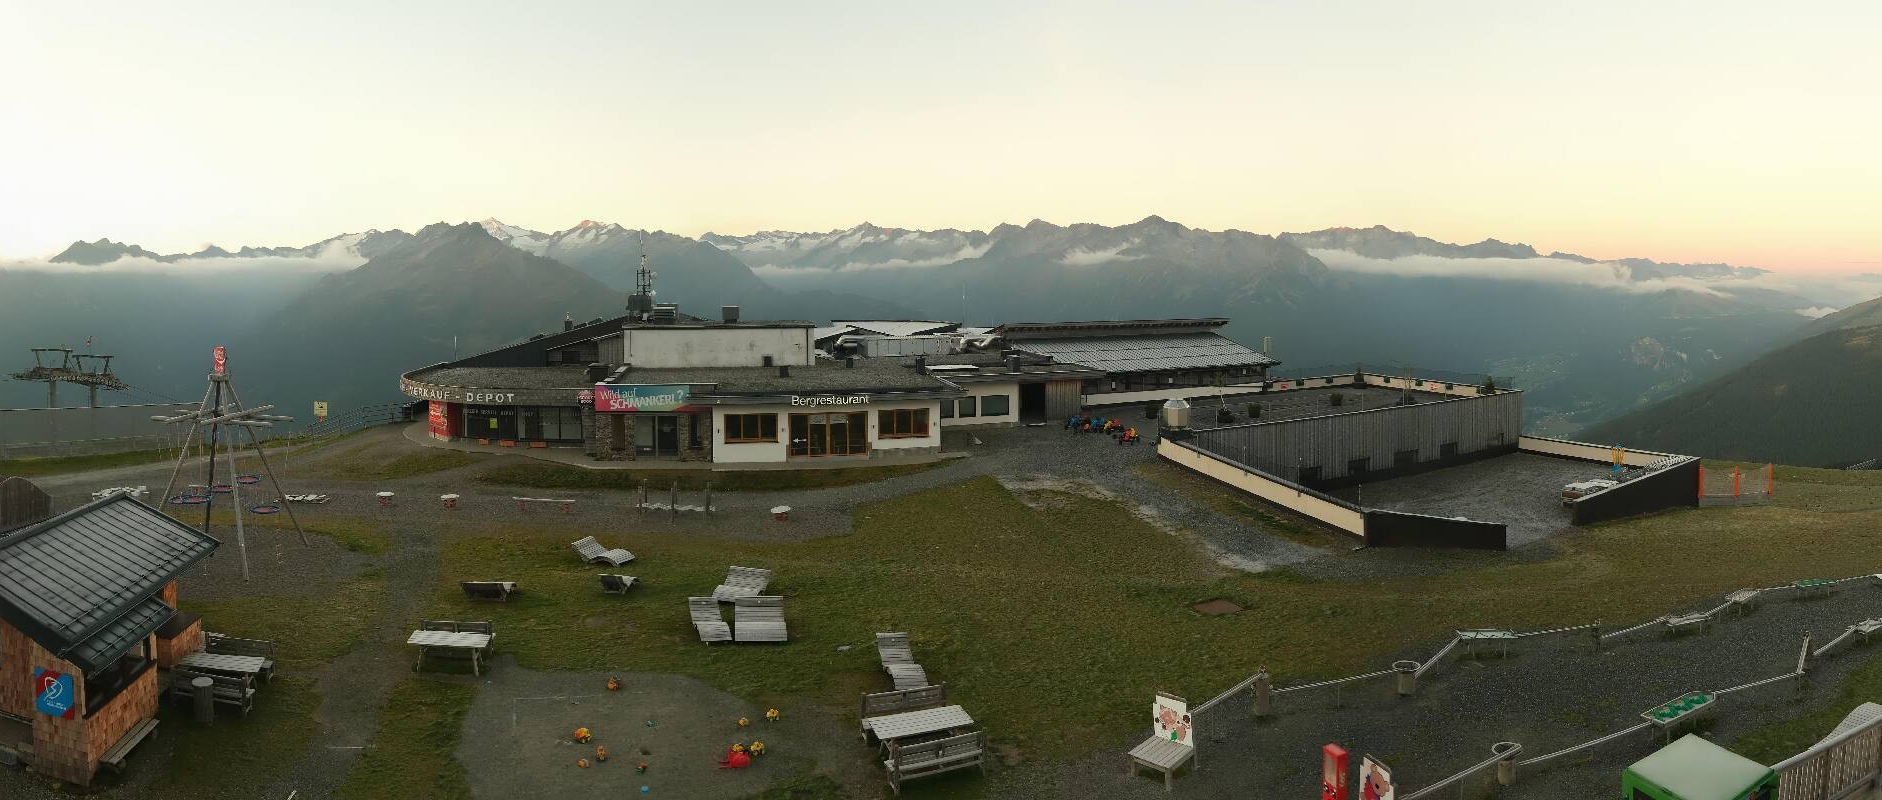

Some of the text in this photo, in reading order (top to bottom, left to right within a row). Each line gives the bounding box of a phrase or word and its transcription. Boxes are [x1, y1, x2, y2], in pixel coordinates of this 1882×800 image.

[409, 385, 450, 400] VERKAUF
[466, 392, 515, 403] DEPOT
[600, 389, 620, 400] Wild
[791, 395, 870, 408] Bergrestaurant
